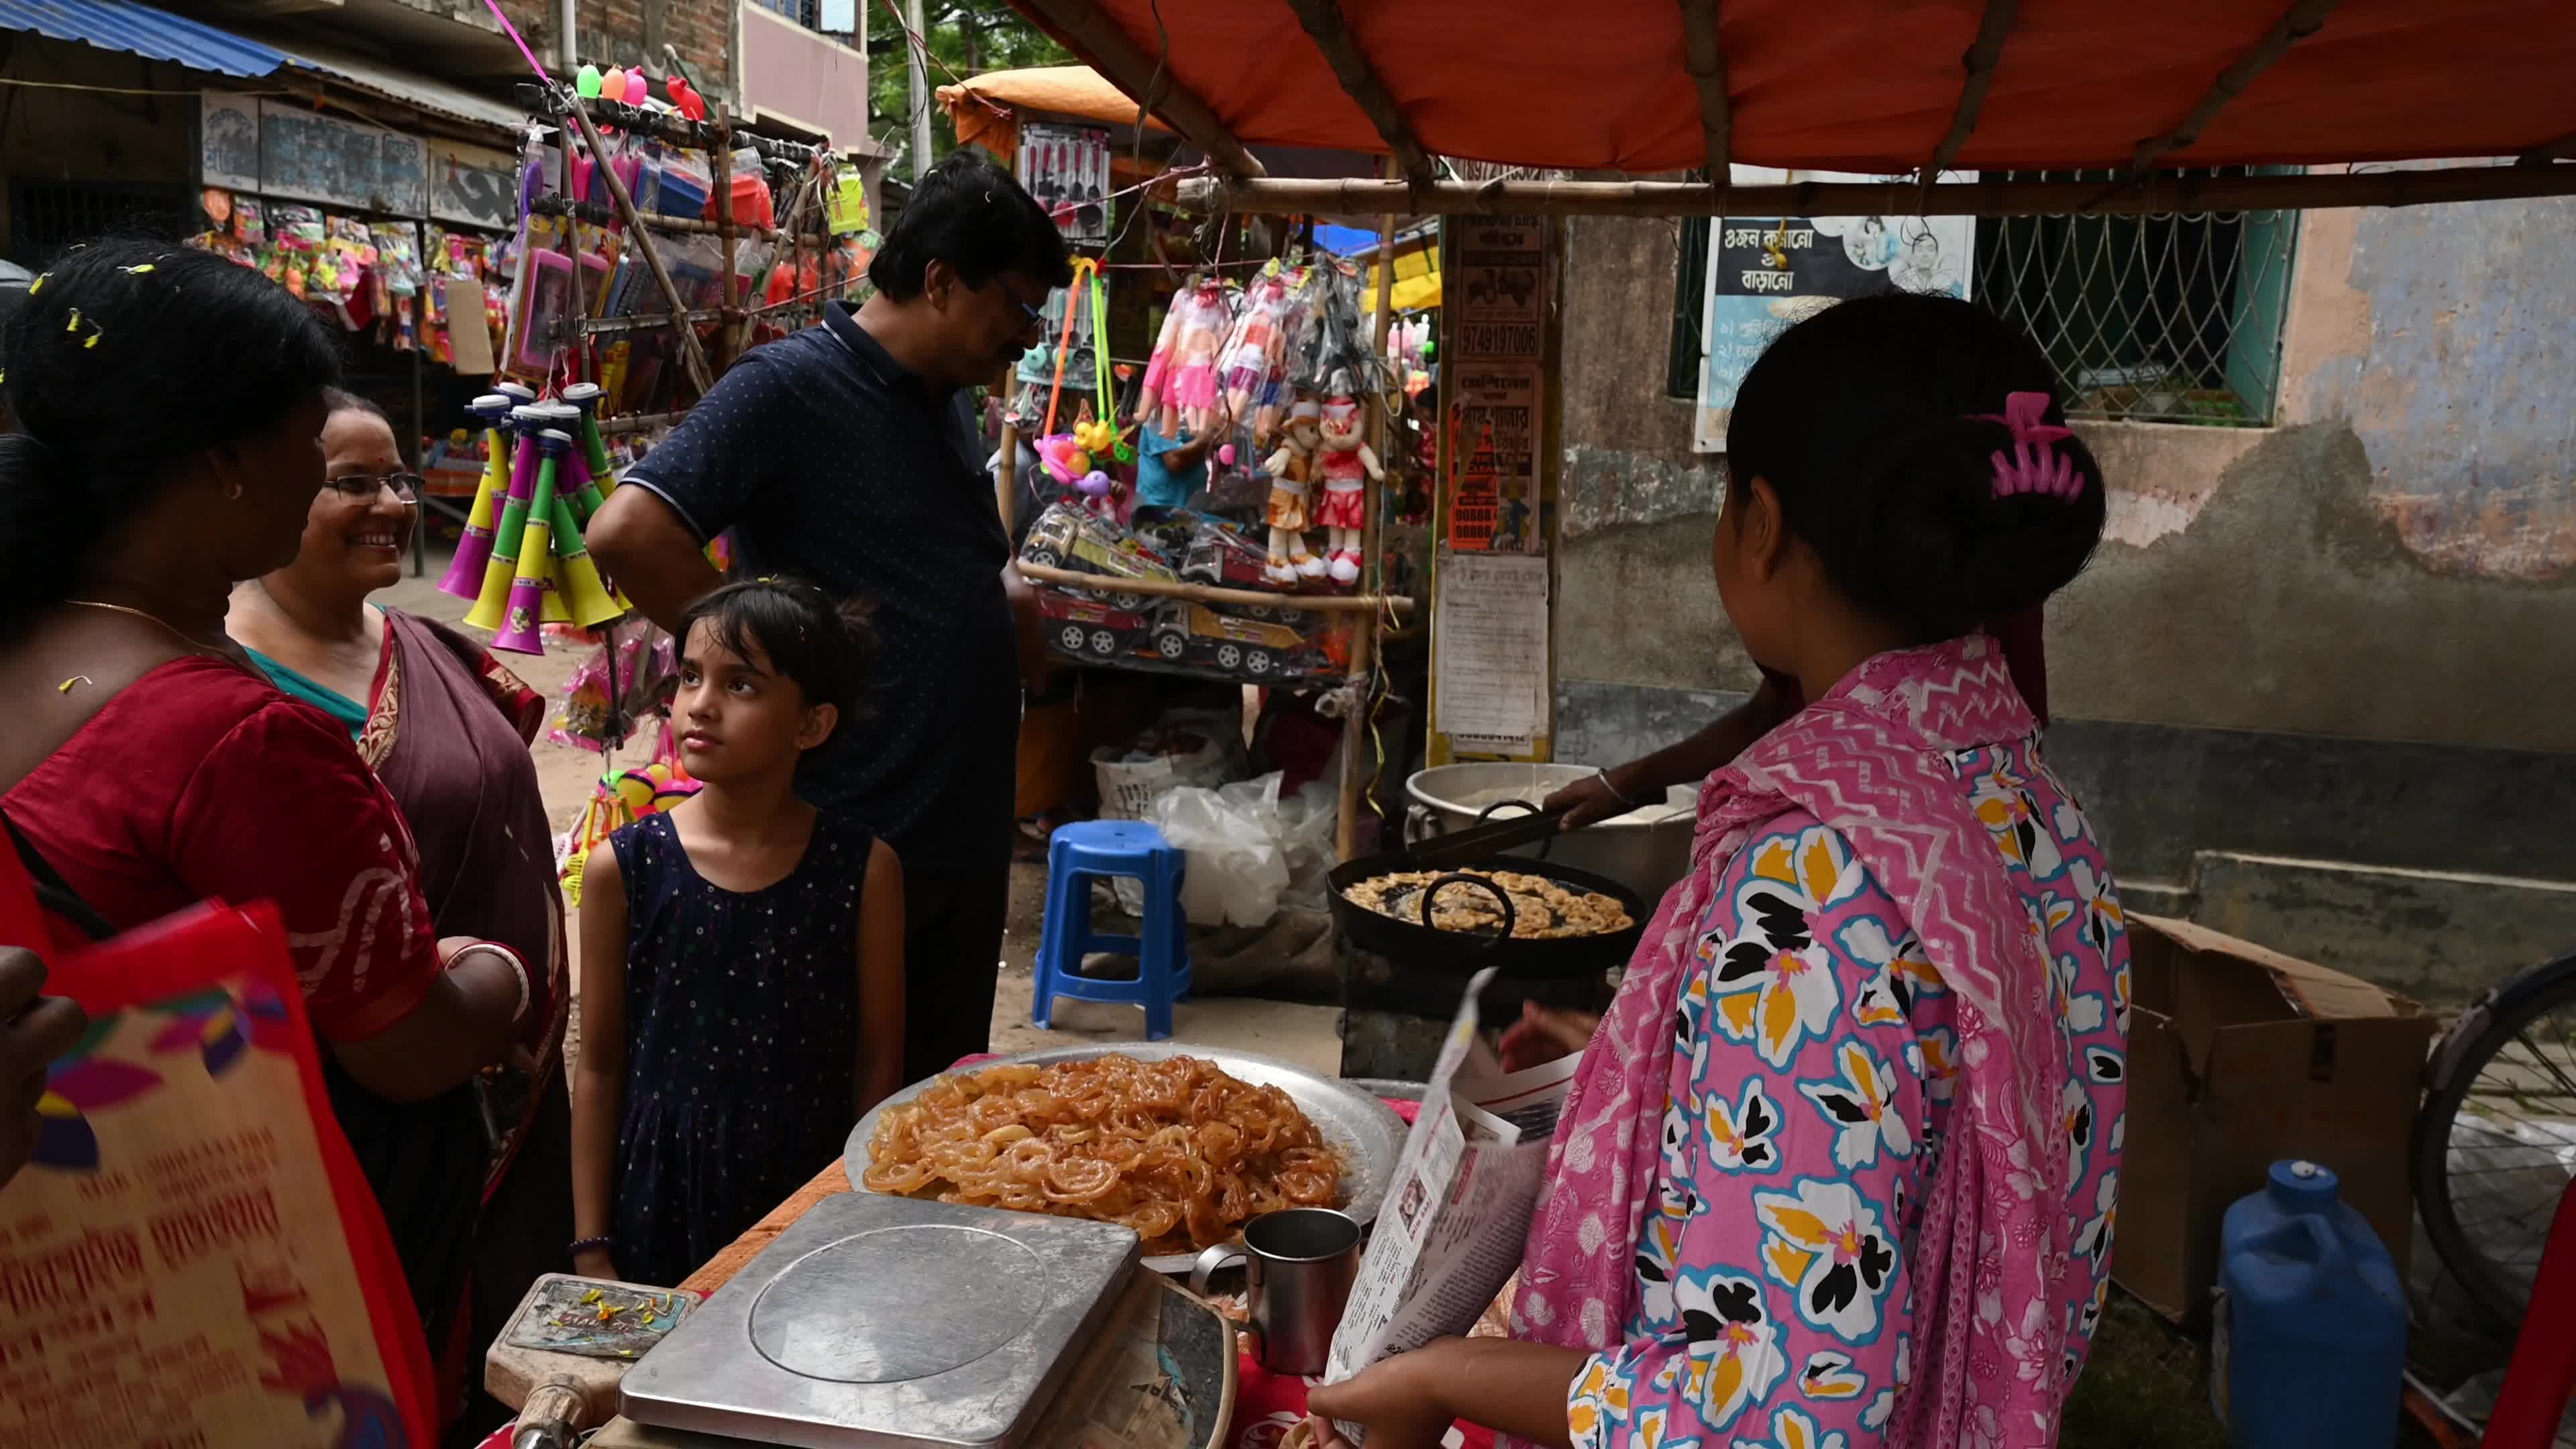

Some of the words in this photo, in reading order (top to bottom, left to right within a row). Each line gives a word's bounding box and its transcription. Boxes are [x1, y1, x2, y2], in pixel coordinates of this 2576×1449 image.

[1724, 228, 1760, 250] ওজন
[1741, 270, 1795, 293] বাড়ানো
[1464, 326, 1536, 352] 9749197006
